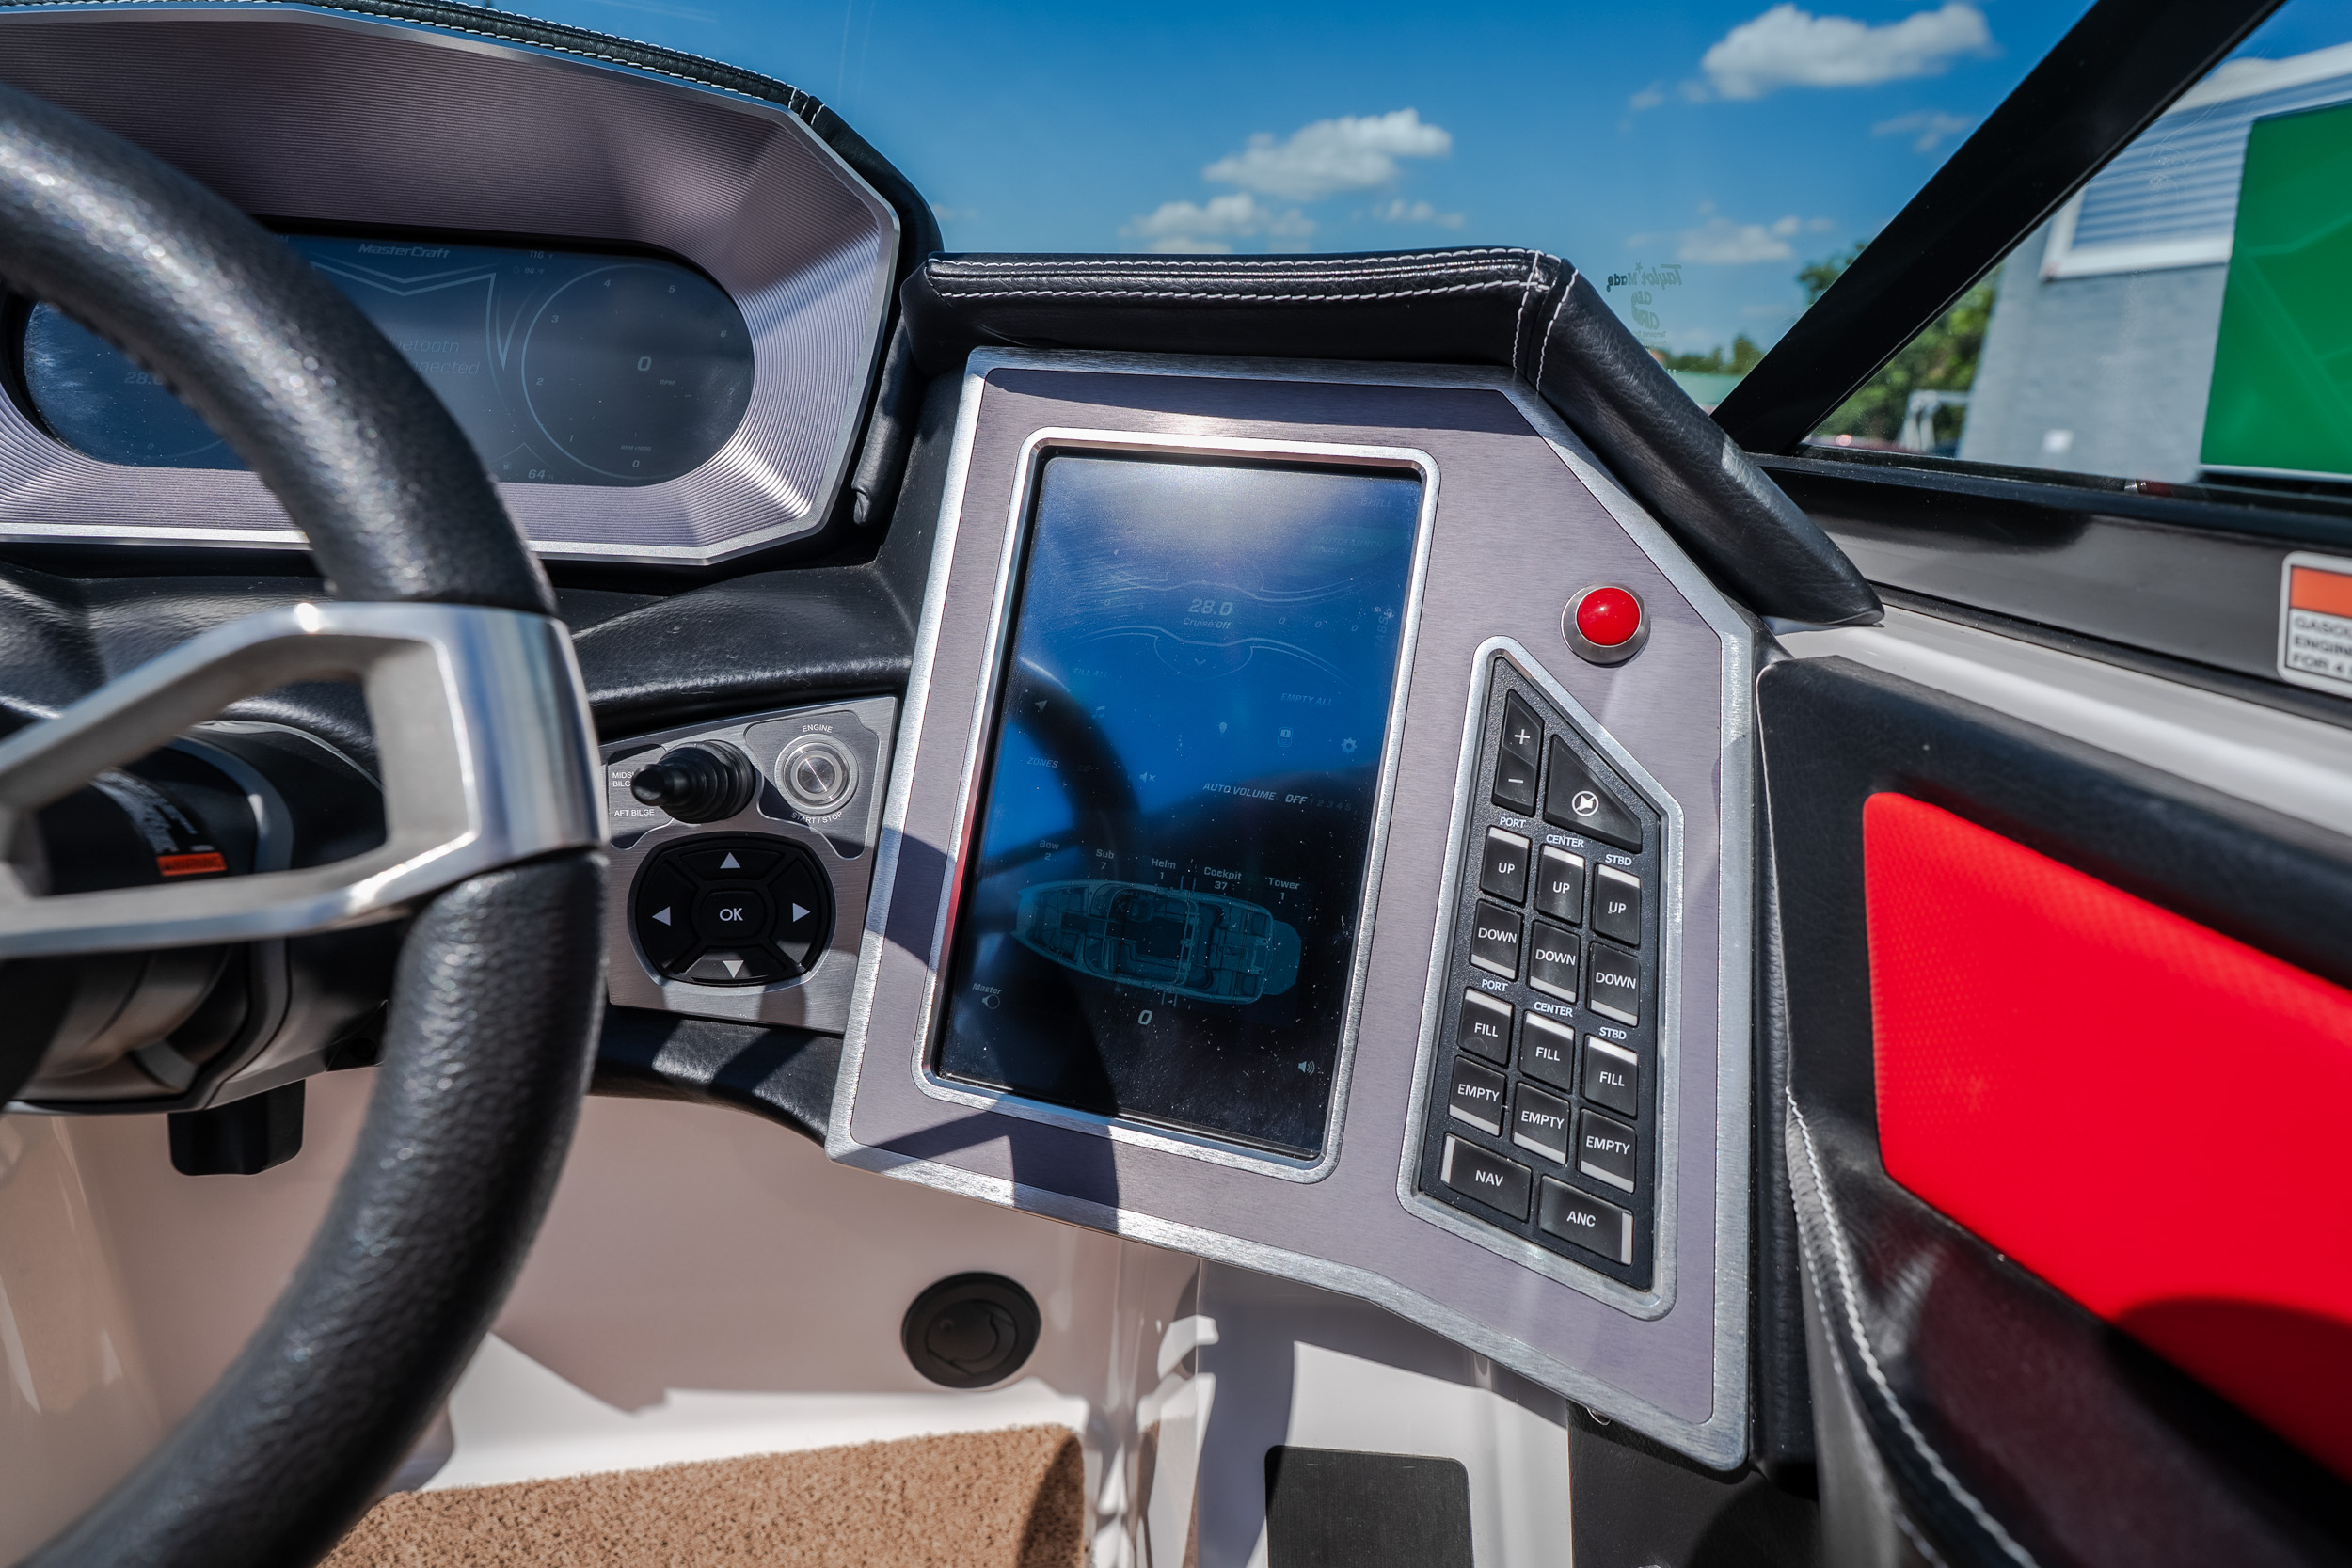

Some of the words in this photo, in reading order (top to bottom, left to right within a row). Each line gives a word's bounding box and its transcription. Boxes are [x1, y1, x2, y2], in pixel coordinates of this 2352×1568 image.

[358, 243, 451, 259] MasterCraft
[604, 278, 612, 288] 4
[668, 285, 675, 293] 5
[551, 315, 559, 324] 3
[720, 329, 727, 338] 6
[637, 356, 652, 372] 0
[535, 377, 544, 386] 2
[632, 459, 641, 468] 0
[528, 468, 546, 480] 64
[1188, 597, 1233, 616] 28.0
[1184, 617, 1214, 627] Cruise
[1216, 620, 1232, 629] Off
[1280, 692, 1313, 704] EMPTY
[1315, 696, 1333, 706] ALL
[802, 723, 834, 735] ENGINE
[1026, 756, 1058, 768] ZONES
[1202, 782, 1231, 794] AUTO
[1233, 786, 1277, 800] VOLUME
[1284, 793, 1309, 805] OFF
[790, 811, 816, 825] START
[821, 811, 843, 825] STOP
[1500, 816, 1527, 829] PORT
[1039, 839, 1059, 850] Bow
[1546, 833, 1585, 848] CENTER
[1044, 852, 1051, 861] 2
[1095, 847, 1114, 860] Sub
[1605, 853, 1632, 866] STBD
[1101, 861, 1107, 870] 7
[1151, 857, 1176, 870] Helm
[1498, 863, 1516, 875] UP
[1159, 871, 1165, 880] 1
[1203, 865, 1242, 881] Cockpit
[1214, 880, 1228, 891] 37
[1268, 877, 1301, 891] Tower
[1552, 881, 1570, 895] UP
[719, 907, 743, 922] OK
[1609, 901, 1627, 914] UP
[1478, 927, 1518, 944] DOWN
[1535, 948, 1576, 966] DOWN
[1481, 979, 1509, 992] PORT
[1595, 972, 1636, 990] DOWN
[972, 982, 1003, 996] Master
[1534, 1001, 1573, 1018] CENTER
[1137, 1009, 1153, 1026] 0
[1474, 1022, 1499, 1037] FILL
[1599, 1026, 1627, 1040] STBD
[1535, 1046, 1560, 1062] FILL
[1599, 1071, 1625, 1087] FILL
[1457, 1084, 1500, 1103] EMPTY
[1520, 1110, 1565, 1130] EMPTY
[1586, 1135, 1630, 1156] EMPTY
[1475, 1169, 1503, 1187] NAV
[1566, 1211, 1596, 1227] ANC
